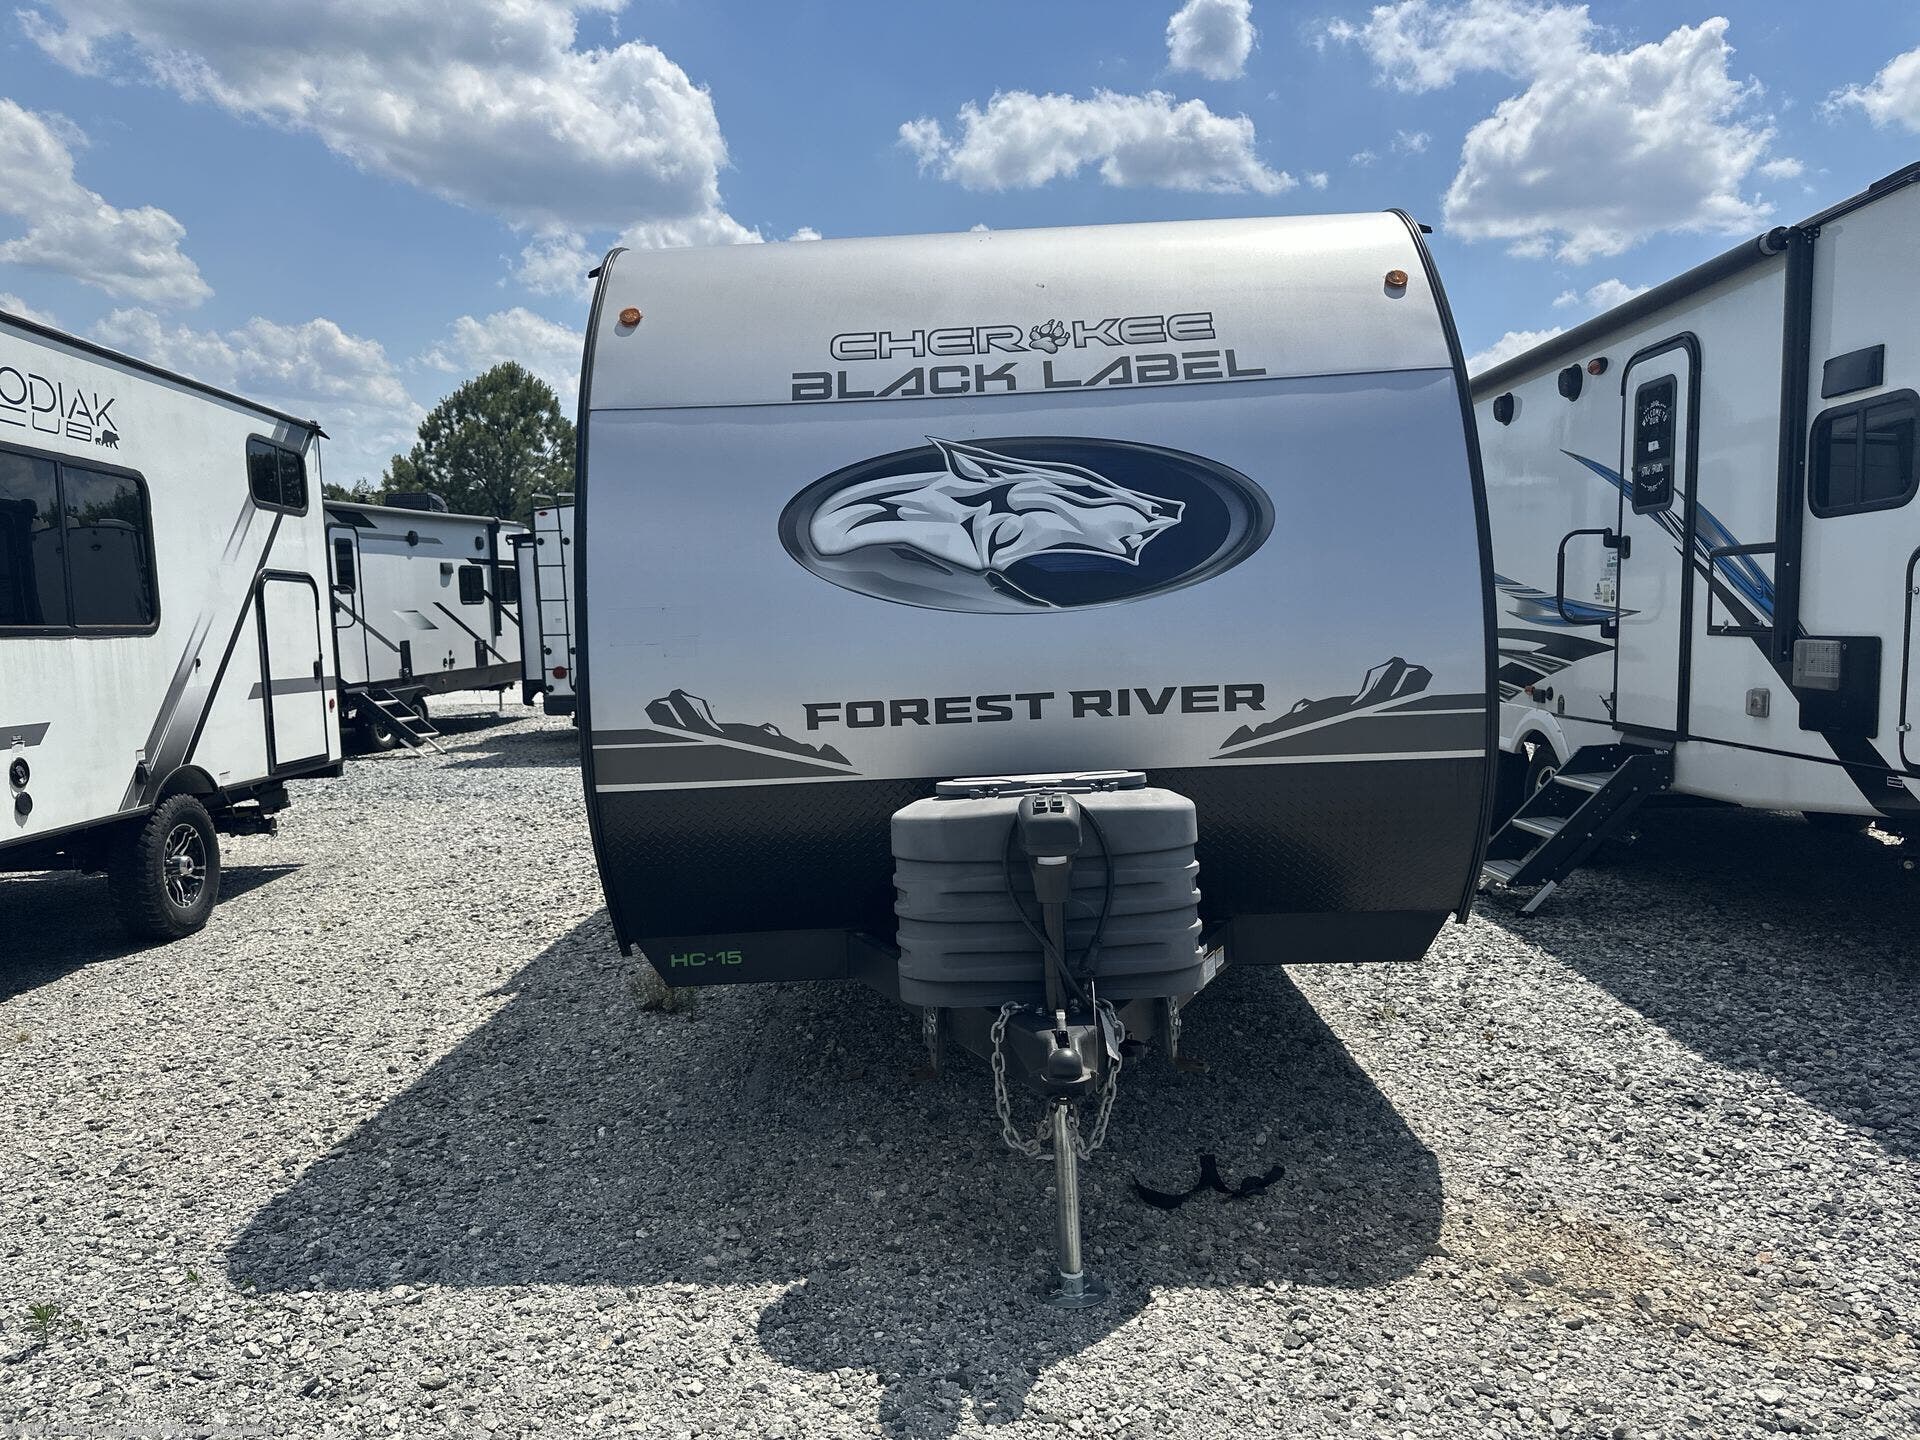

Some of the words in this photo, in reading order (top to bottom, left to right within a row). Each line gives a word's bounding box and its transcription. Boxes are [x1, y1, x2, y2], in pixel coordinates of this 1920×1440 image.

[791, 362, 1018, 401] BLACK
[1043, 348, 1268, 389] LABEL
[803, 691, 1055, 731] FOREST
[1068, 683, 1267, 718] RIVER
[671, 951, 742, 967] HC-15
